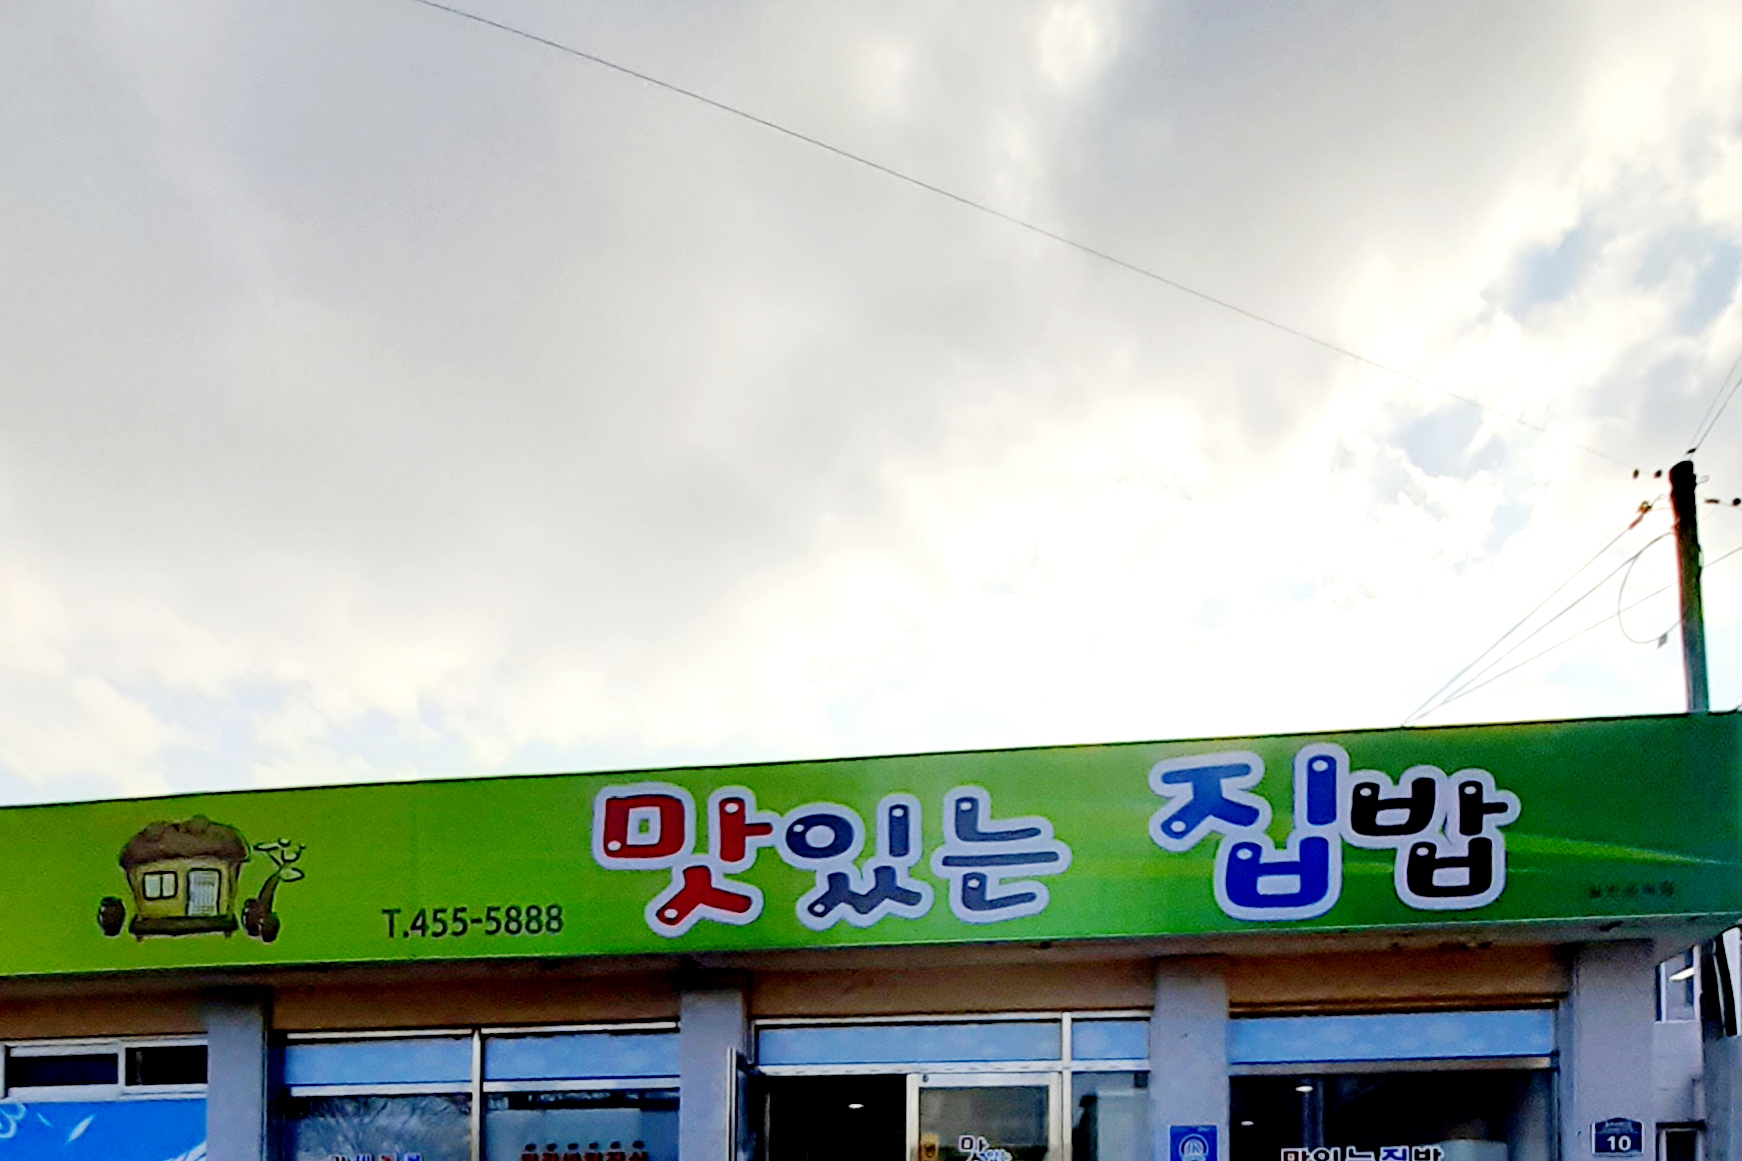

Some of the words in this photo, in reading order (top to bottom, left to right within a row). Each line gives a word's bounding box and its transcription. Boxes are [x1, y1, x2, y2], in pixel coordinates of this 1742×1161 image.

[595, 782, 1071, 935] 맛있는
[1150, 743, 1520, 922] 집밥
[381, 904, 564, 939] T.455-5888
[1607, 1135, 1631, 1151] 10
